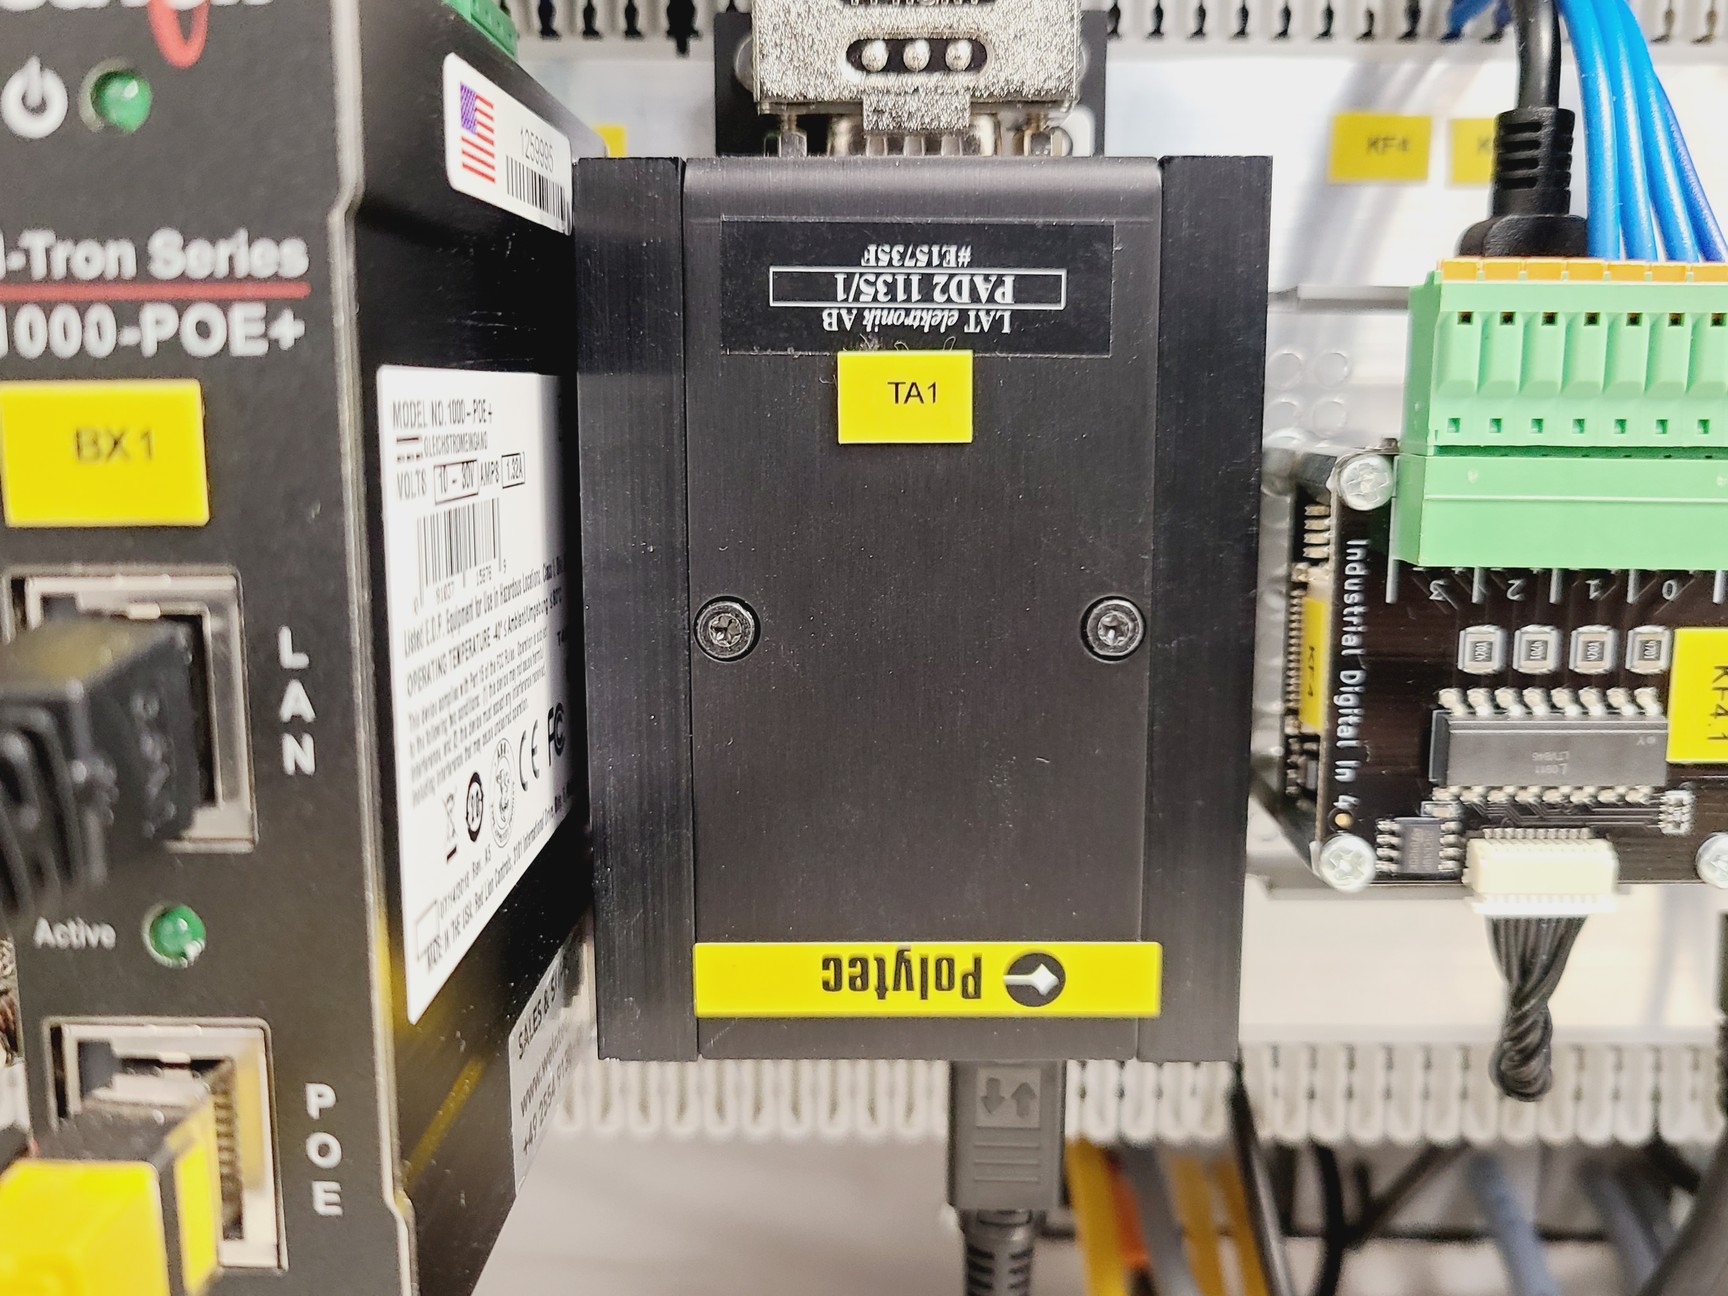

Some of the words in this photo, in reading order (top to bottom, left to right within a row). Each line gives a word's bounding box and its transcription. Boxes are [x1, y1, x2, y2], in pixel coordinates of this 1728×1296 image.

[520, 126, 554, 173] 1259995
[148, 227, 310, 281] Series
[861, 244, 972, 267] #E15735F
[836, 273, 921, 304] 1135/1
[933, 274, 1016, 304] PAD2
[823, 308, 857, 332] AB
[862, 307, 959, 333] elektronik
[965, 309, 1011, 333] LAT
[888, 381, 938, 405] TA1
[391, 401, 427, 430] MODEL
[396, 468, 427, 501] VOLTS
[479, 459, 500, 486] AMPS
[1341, 539, 1369, 657] Industrial
[1429, 579, 1448, 600] 3
[1507, 579, 1526, 600] 2
[1588, 579, 1602, 600] 1
[1662, 579, 1679, 600] 0
[406, 652, 447, 698] OPERATING
[448, 626, 490, 671] TEMPERATURE
[1333, 669, 1366, 747] Digital
[1333, 758, 1360, 782] In
[1333, 794, 1360, 809] 4
[34, 917, 116, 949] Active
[821, 946, 982, 1000] Polytec
[517, 998, 543, 1060] SALES
